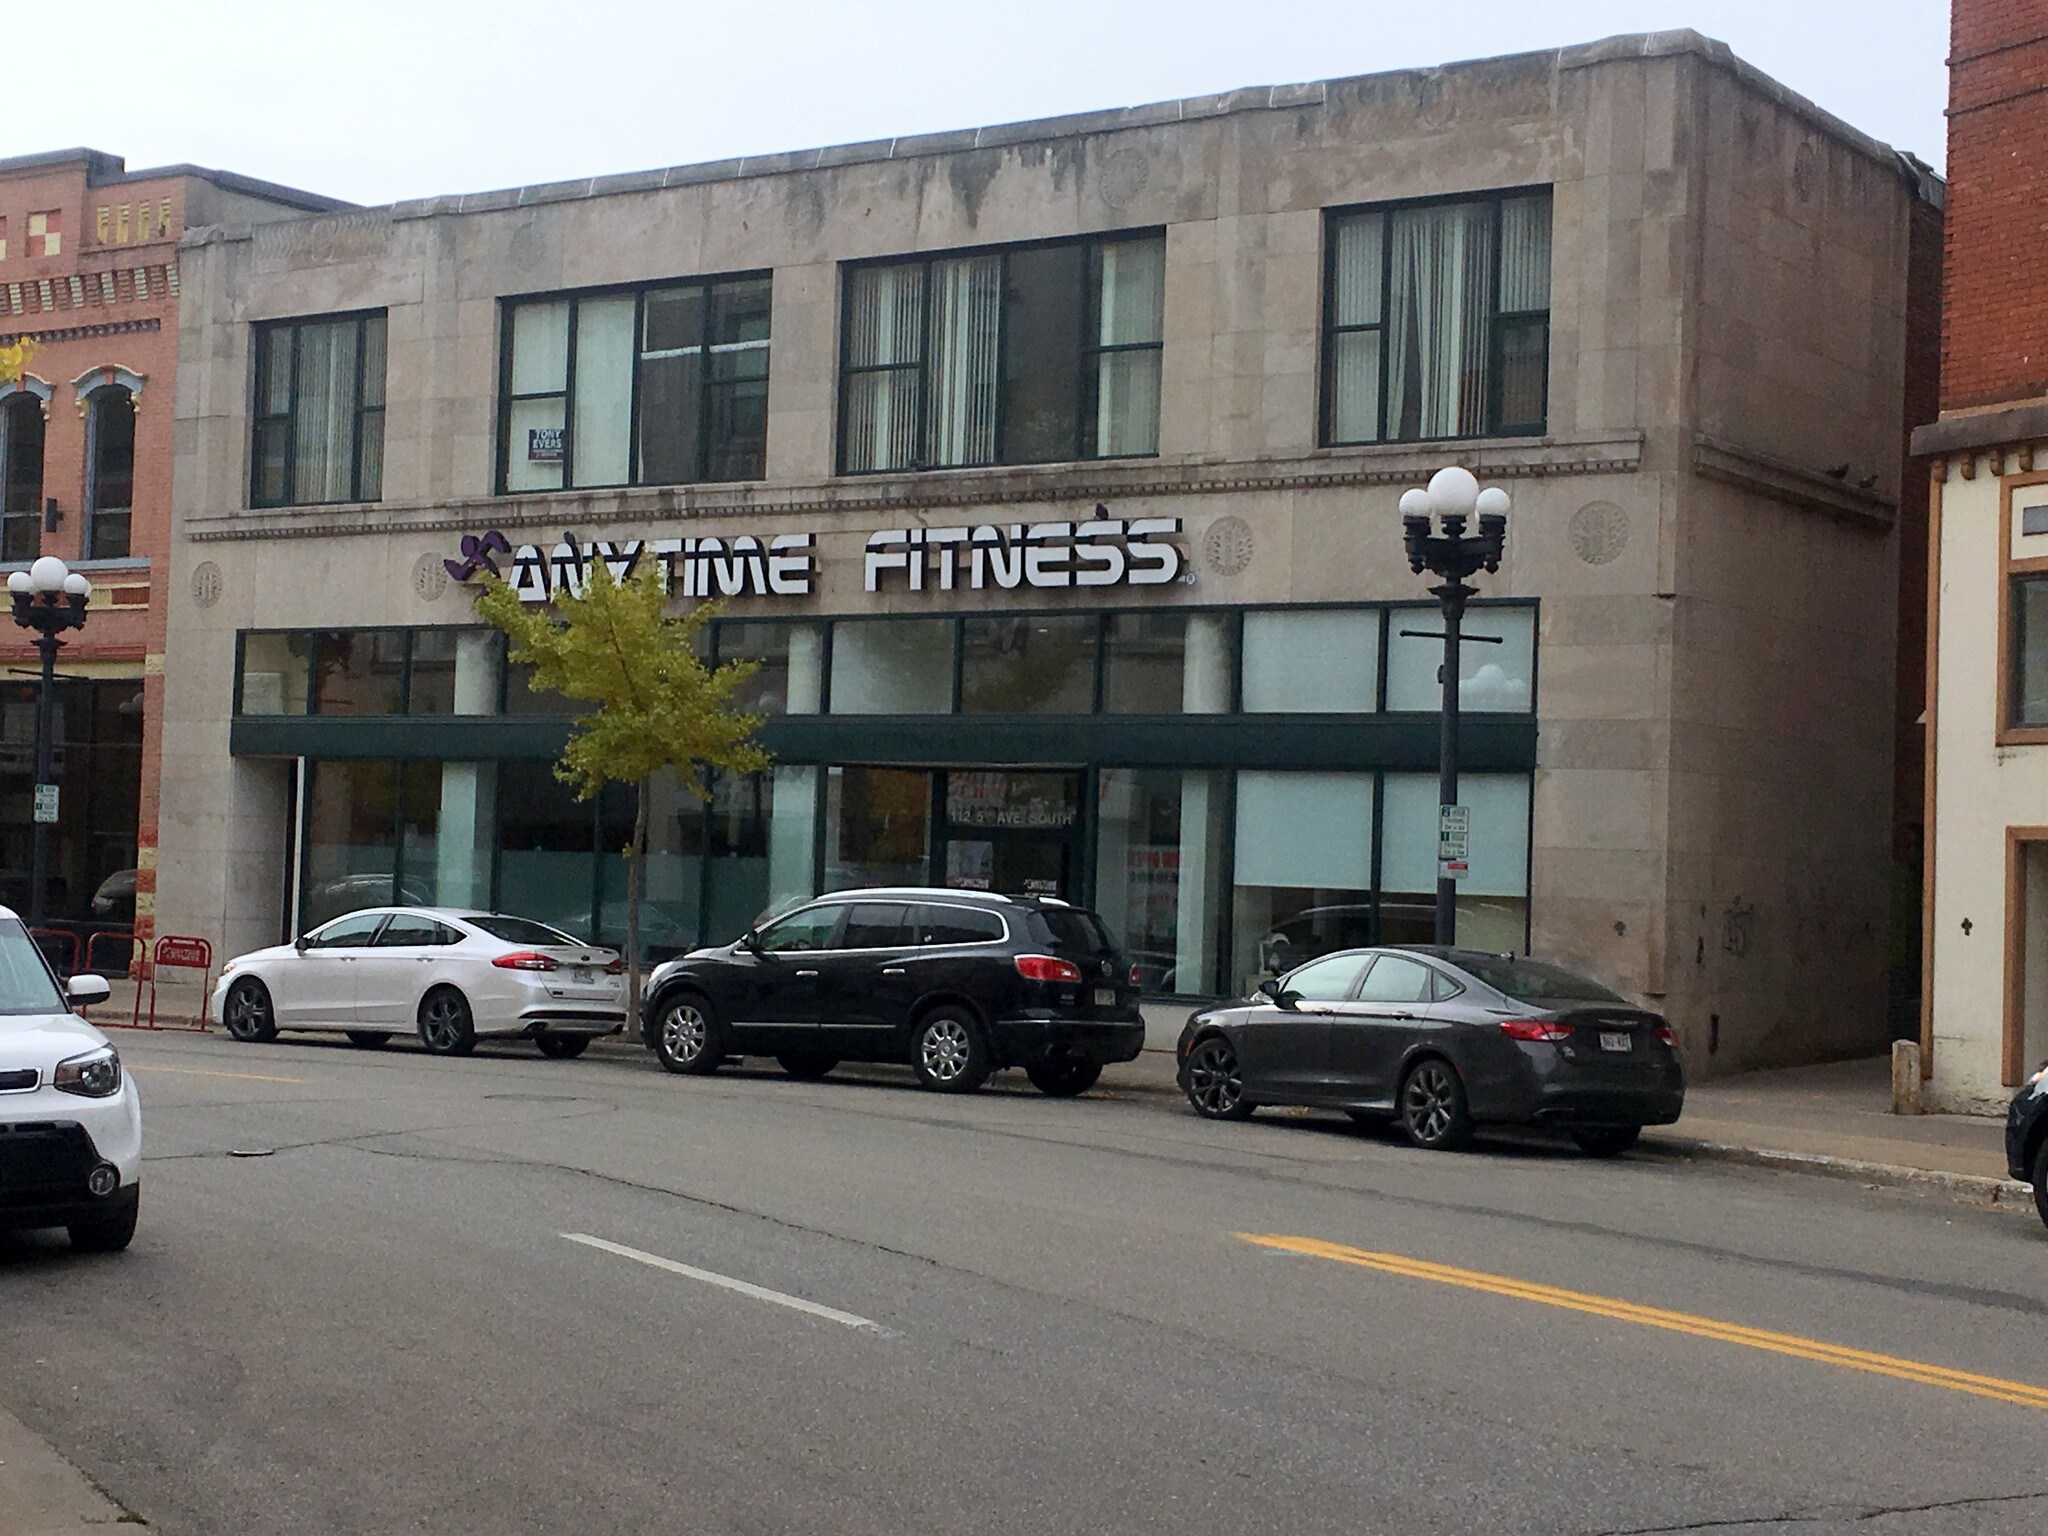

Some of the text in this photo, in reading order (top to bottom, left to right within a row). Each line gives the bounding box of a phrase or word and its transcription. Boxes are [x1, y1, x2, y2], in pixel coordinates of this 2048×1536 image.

[535, 429, 562, 439] TONY
[532, 439, 562, 448] EVERS
[508, 518, 1182, 602] ANYTIME FITNESS
[997, 811, 1022, 825] AVE
[1028, 811, 1072, 825] SOUTH
